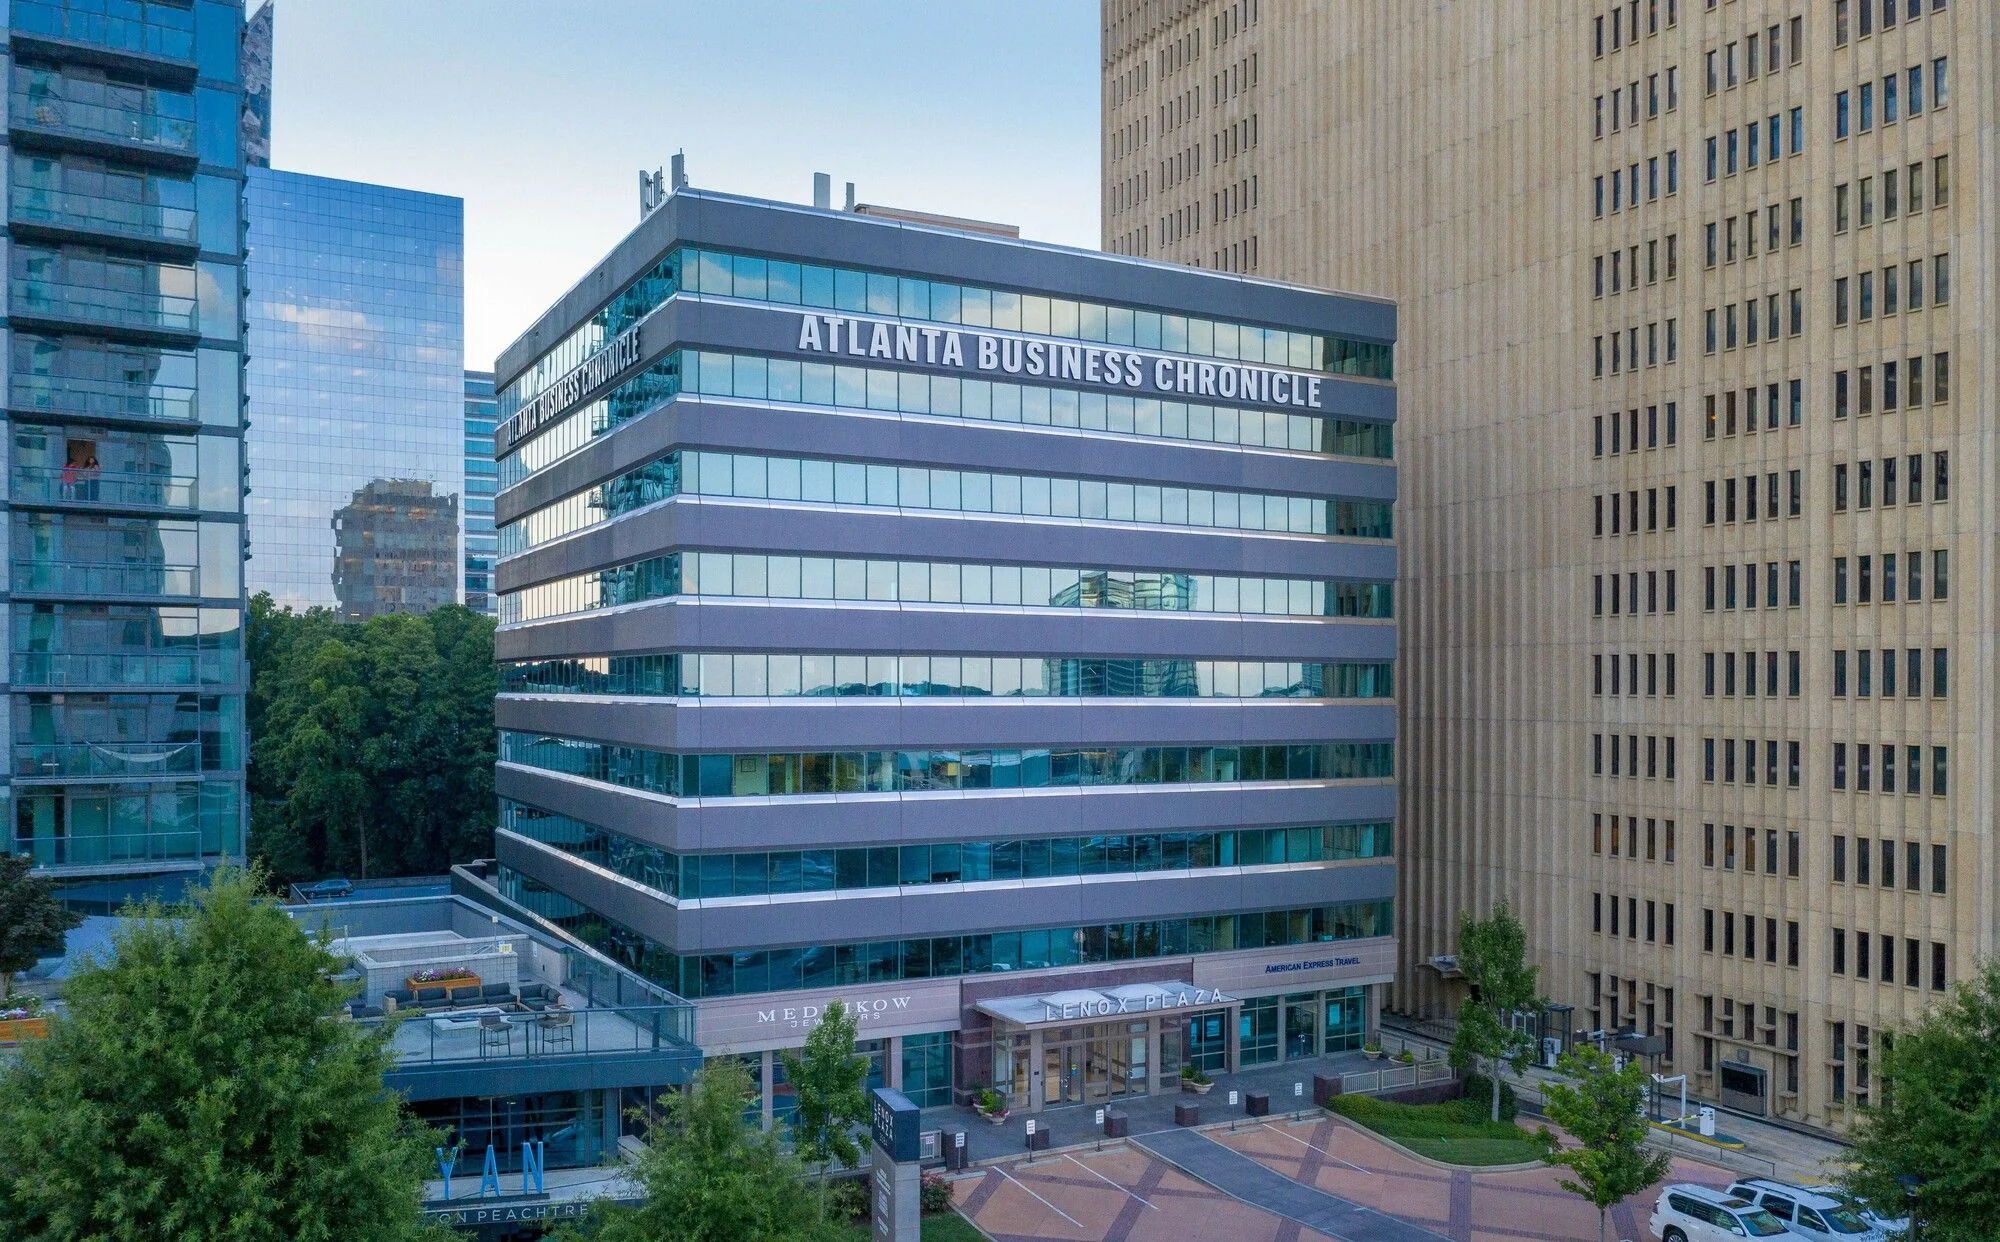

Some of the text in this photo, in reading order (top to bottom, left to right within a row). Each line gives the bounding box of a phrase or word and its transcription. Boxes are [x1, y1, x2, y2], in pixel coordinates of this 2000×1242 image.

[799, 314, 1322, 408] ATLANTA BUSINESS CHRONICLE
[507, 328, 640, 446] ATLANTA BUSINESS CHRONICLE
[790, 1012, 881, 1028] JEWRS
[1045, 988, 1222, 1021] LENOX PLAZA
[436, 1141, 544, 1200] YAN
[477, 1204, 589, 1222] PEACHTRE
